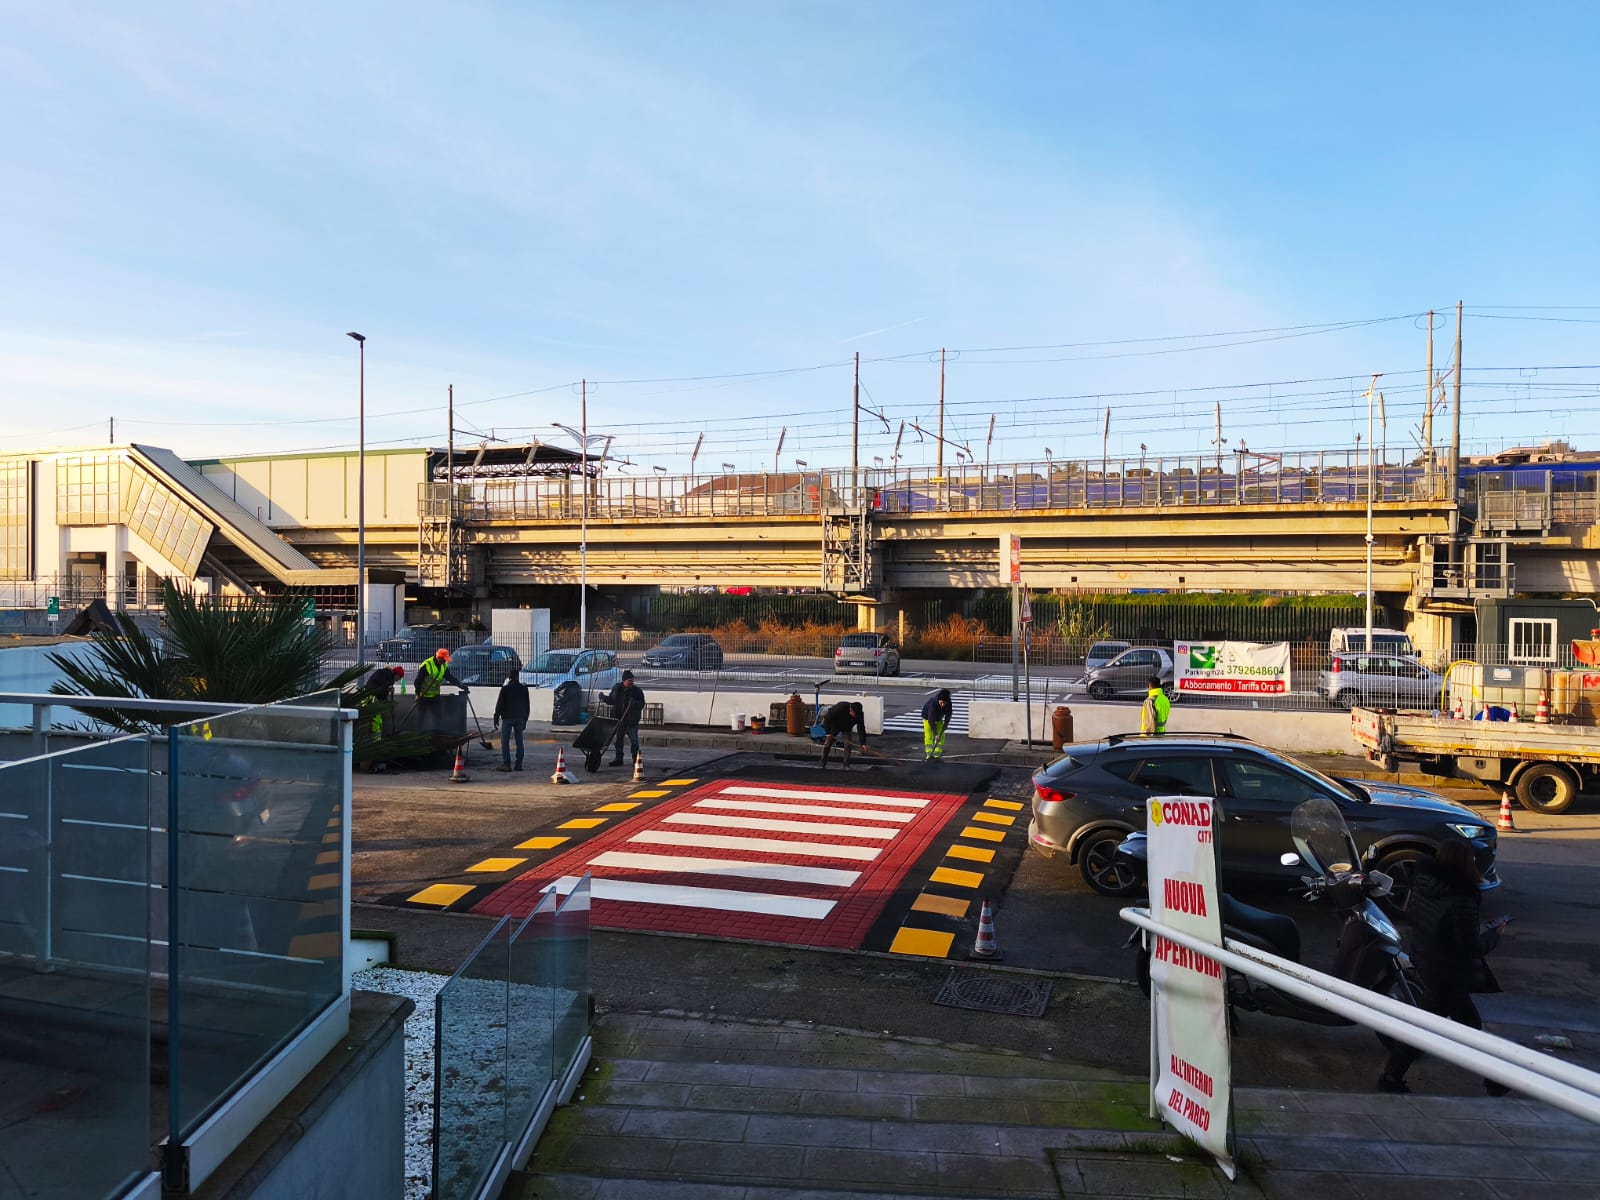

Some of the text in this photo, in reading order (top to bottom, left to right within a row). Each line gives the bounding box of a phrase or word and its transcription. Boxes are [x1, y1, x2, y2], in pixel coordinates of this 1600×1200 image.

[1185, 669, 1210, 677] Parking
[1227, 665, 1284, 675] 3792648604
[1184, 680, 1232, 690] Abbonamento
[1238, 681, 1260, 691] Tariffa
[1261, 682, 1282, 691] Oraria
[1163, 802, 1211, 827] CONAD
[1198, 830, 1212, 844] CITY
[1164, 878, 1207, 917] NUOVA
[1171, 1054, 1213, 1098] ALL'INTERNO
[1168, 1088, 1211, 1132] DEL PARCO
